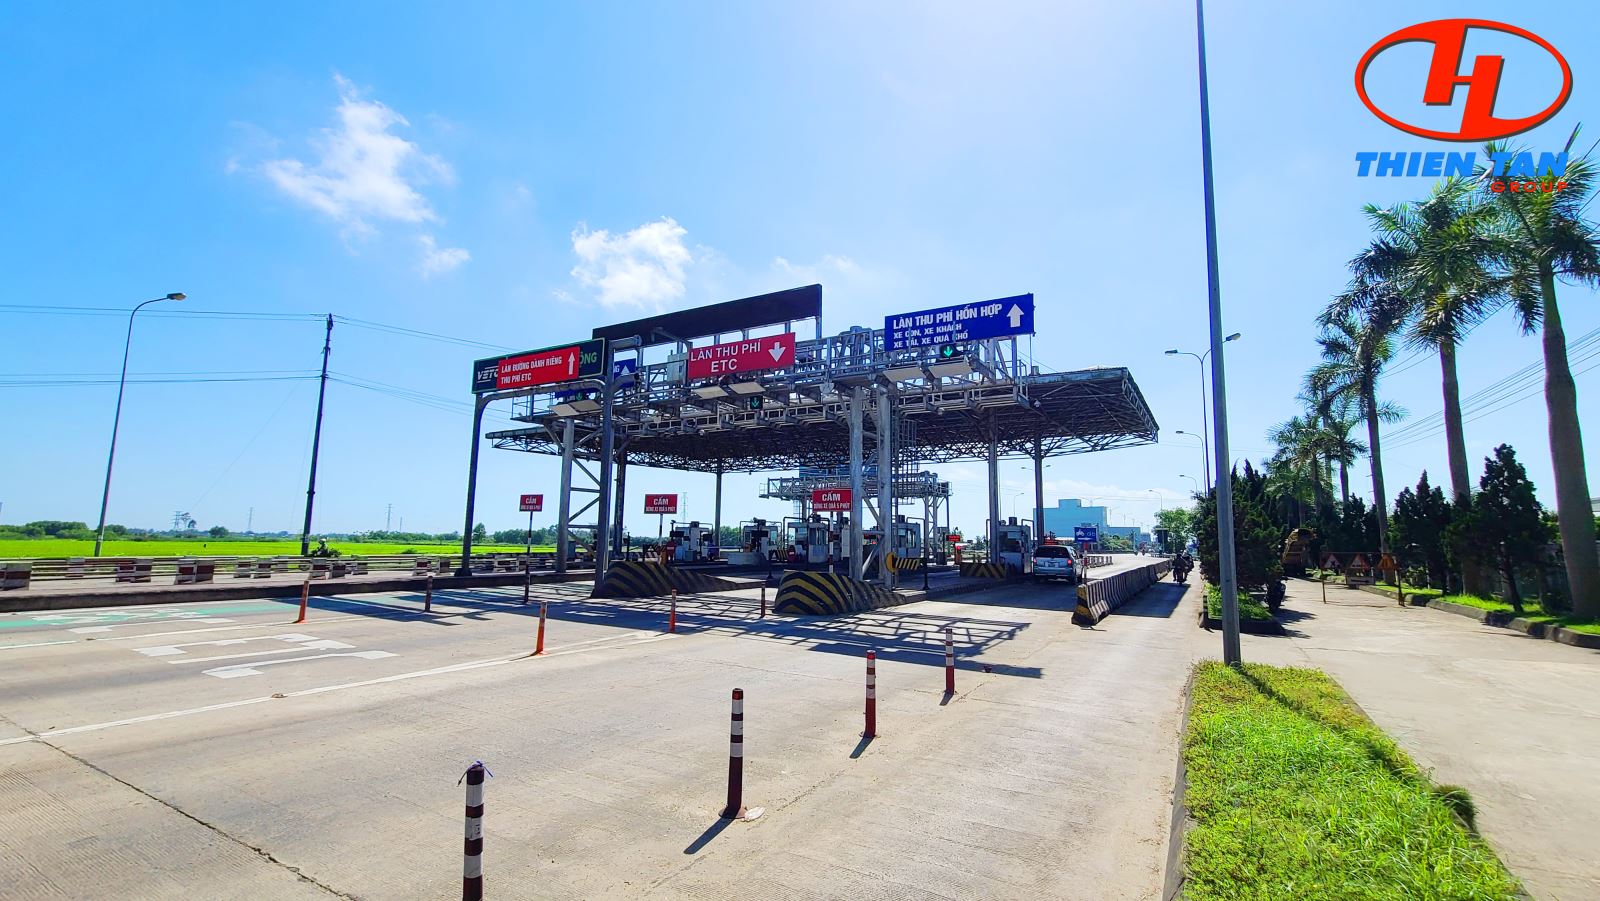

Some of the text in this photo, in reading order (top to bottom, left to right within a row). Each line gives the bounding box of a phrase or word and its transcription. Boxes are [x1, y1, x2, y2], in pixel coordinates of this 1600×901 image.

[893, 316, 913, 330] LÀN
[915, 314, 933, 326] THU
[936, 309, 953, 324] PHÍ
[980, 303, 1003, 318] HỢP
[893, 331, 903, 339] XE
[924, 327, 934, 335] XE
[893, 340, 903, 348] XE
[921, 336, 932, 345] XE
[690, 339, 761, 362] LÀN THU PHÍ
[501, 364, 511, 373] LÀN
[711, 358, 737, 373] ETC
[501, 373, 531, 384] THU PHÍ ETC
[821, 490, 841, 501] CẤM
